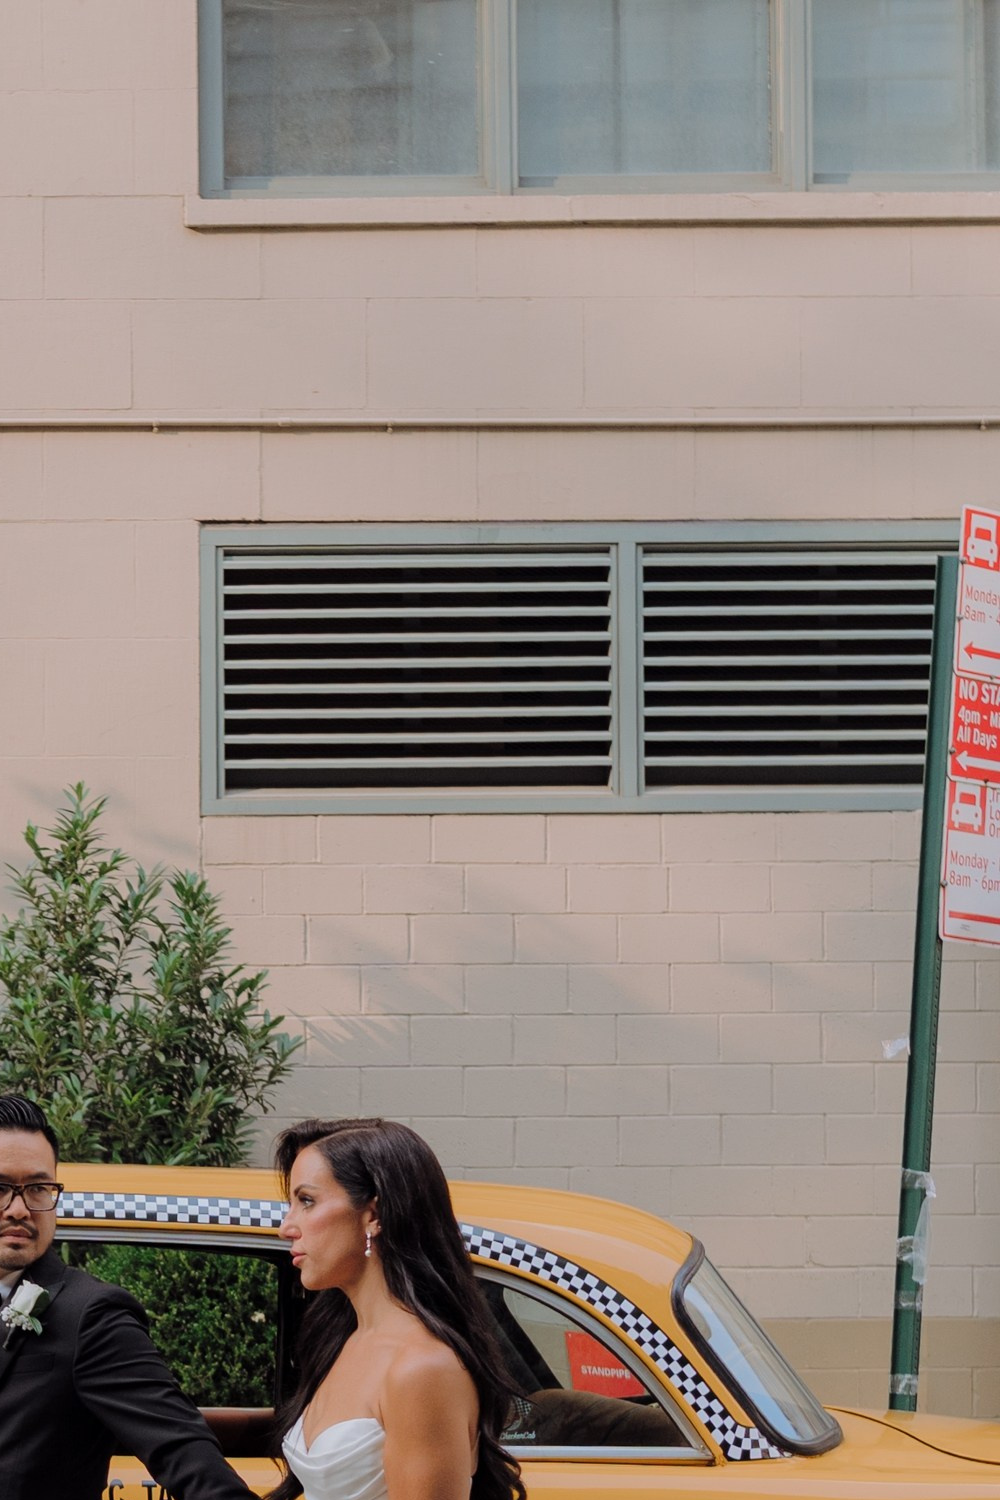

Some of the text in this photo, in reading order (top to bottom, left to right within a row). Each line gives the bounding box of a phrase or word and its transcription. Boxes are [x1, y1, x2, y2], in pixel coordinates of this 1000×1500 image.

[965, 584, 1000, 608] Monda
[963, 604, 986, 624] 8am
[959, 678, 978, 702] NO
[958, 705, 981, 725] 4pm
[957, 726, 998, 751] All Days
[950, 850, 988, 873] Monday
[949, 870, 971, 889] 8am
[581, 1365, 631, 1380] STANDPIPE
